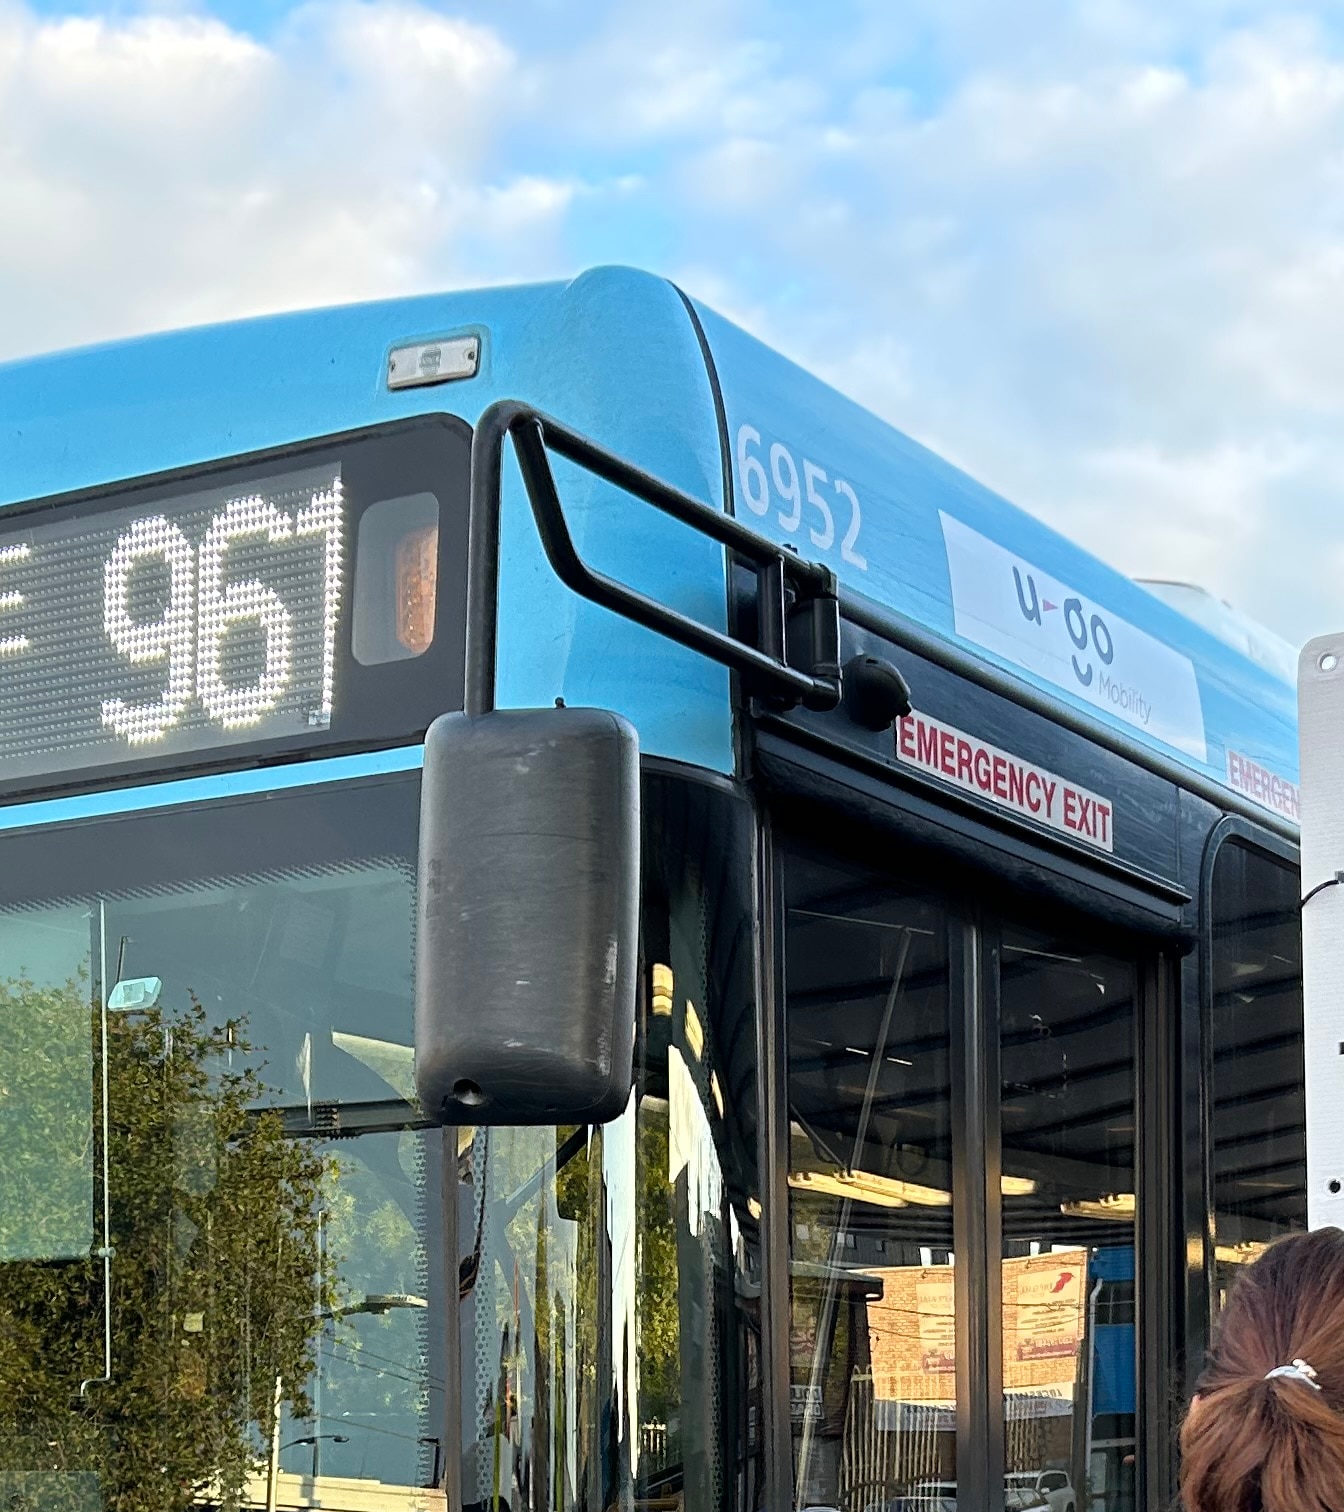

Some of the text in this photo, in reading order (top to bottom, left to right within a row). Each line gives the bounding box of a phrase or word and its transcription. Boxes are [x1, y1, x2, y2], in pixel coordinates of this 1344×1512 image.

[737, 423, 868, 571] 6952
[101, 476, 343, 748] 961
[1099, 671, 1152, 725] Mobility
[900, 715, 1110, 842] EMERGENCY EXIT
